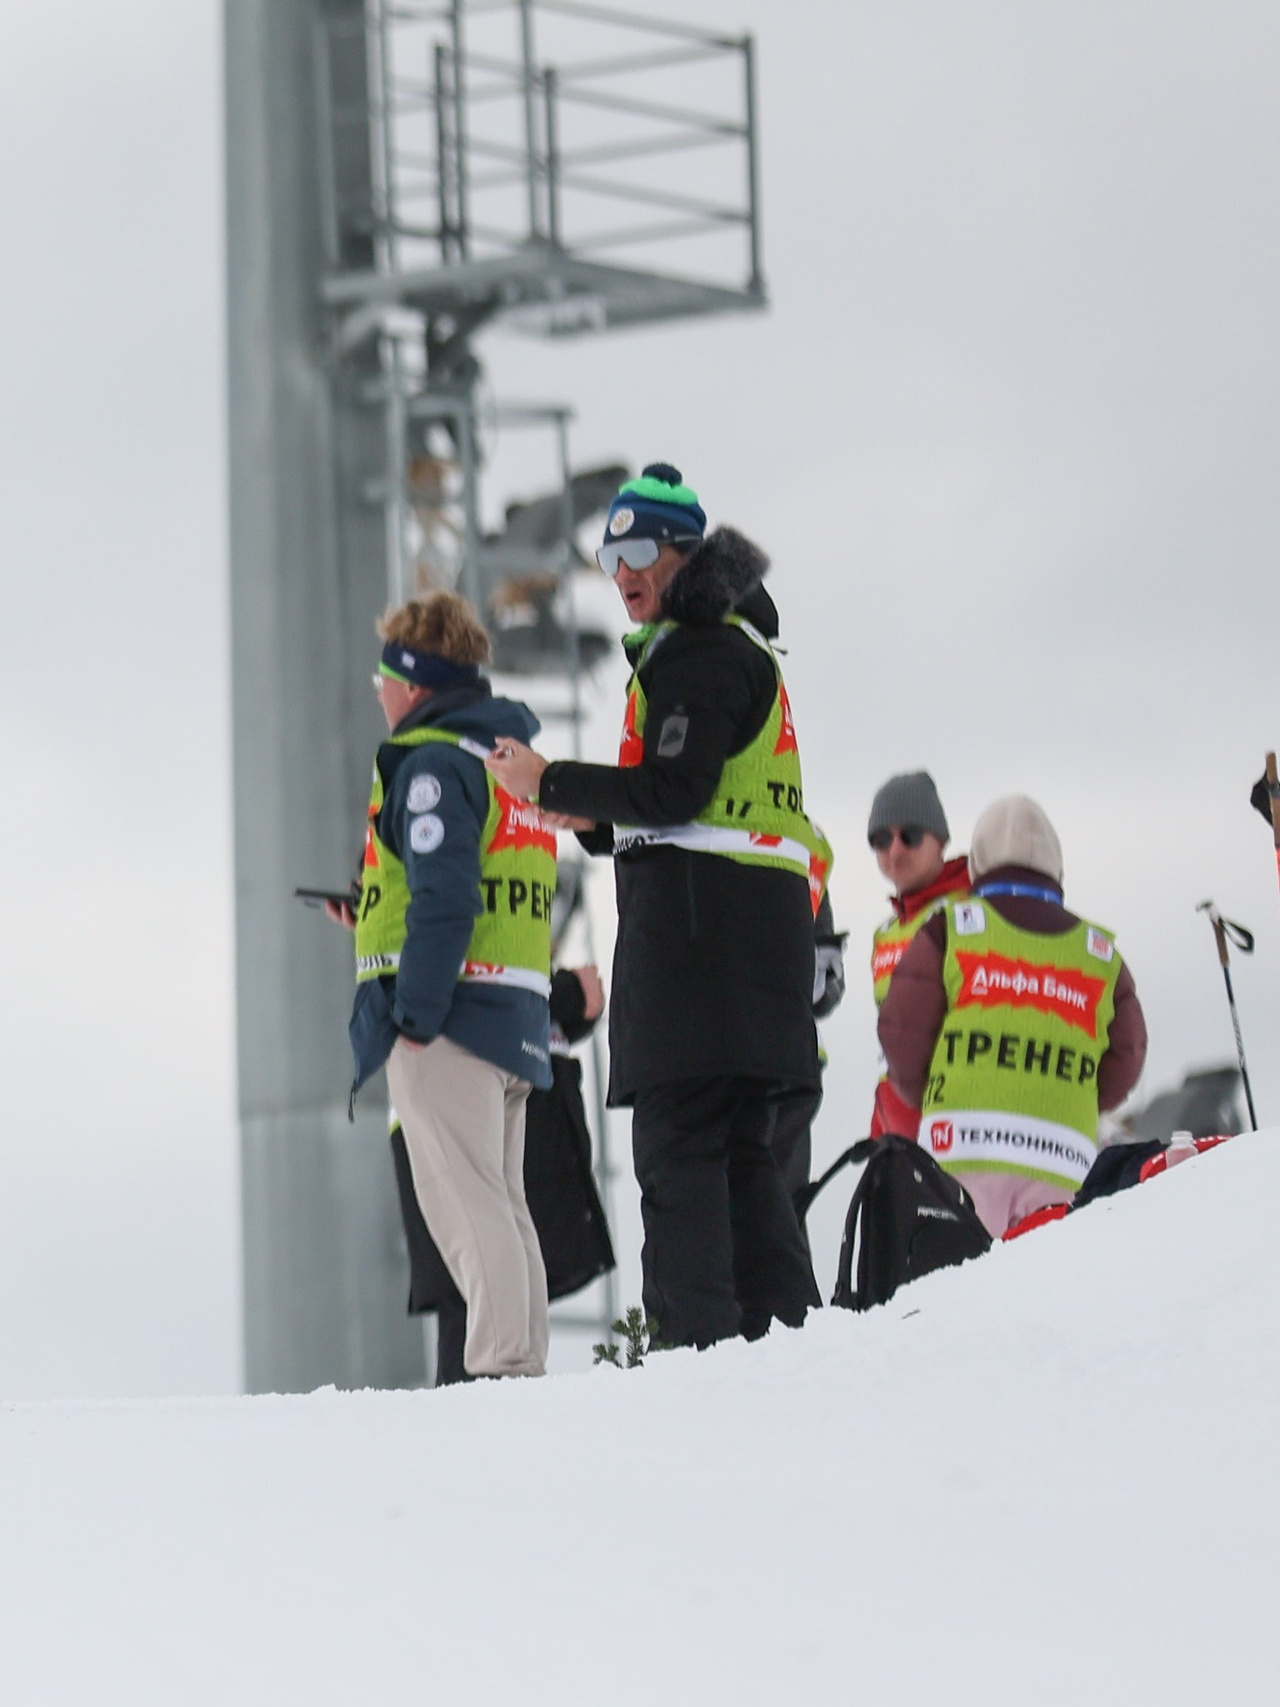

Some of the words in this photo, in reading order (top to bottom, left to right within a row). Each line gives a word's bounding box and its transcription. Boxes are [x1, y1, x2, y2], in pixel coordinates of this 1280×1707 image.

[971, 965, 1039, 996] Альфа
[1043, 974, 1088, 1011] Банк
[944, 1029, 1096, 1086] ТРЕНЕР
[959, 1127, 1091, 1170] ТЕХНОНИКОЛЬ
